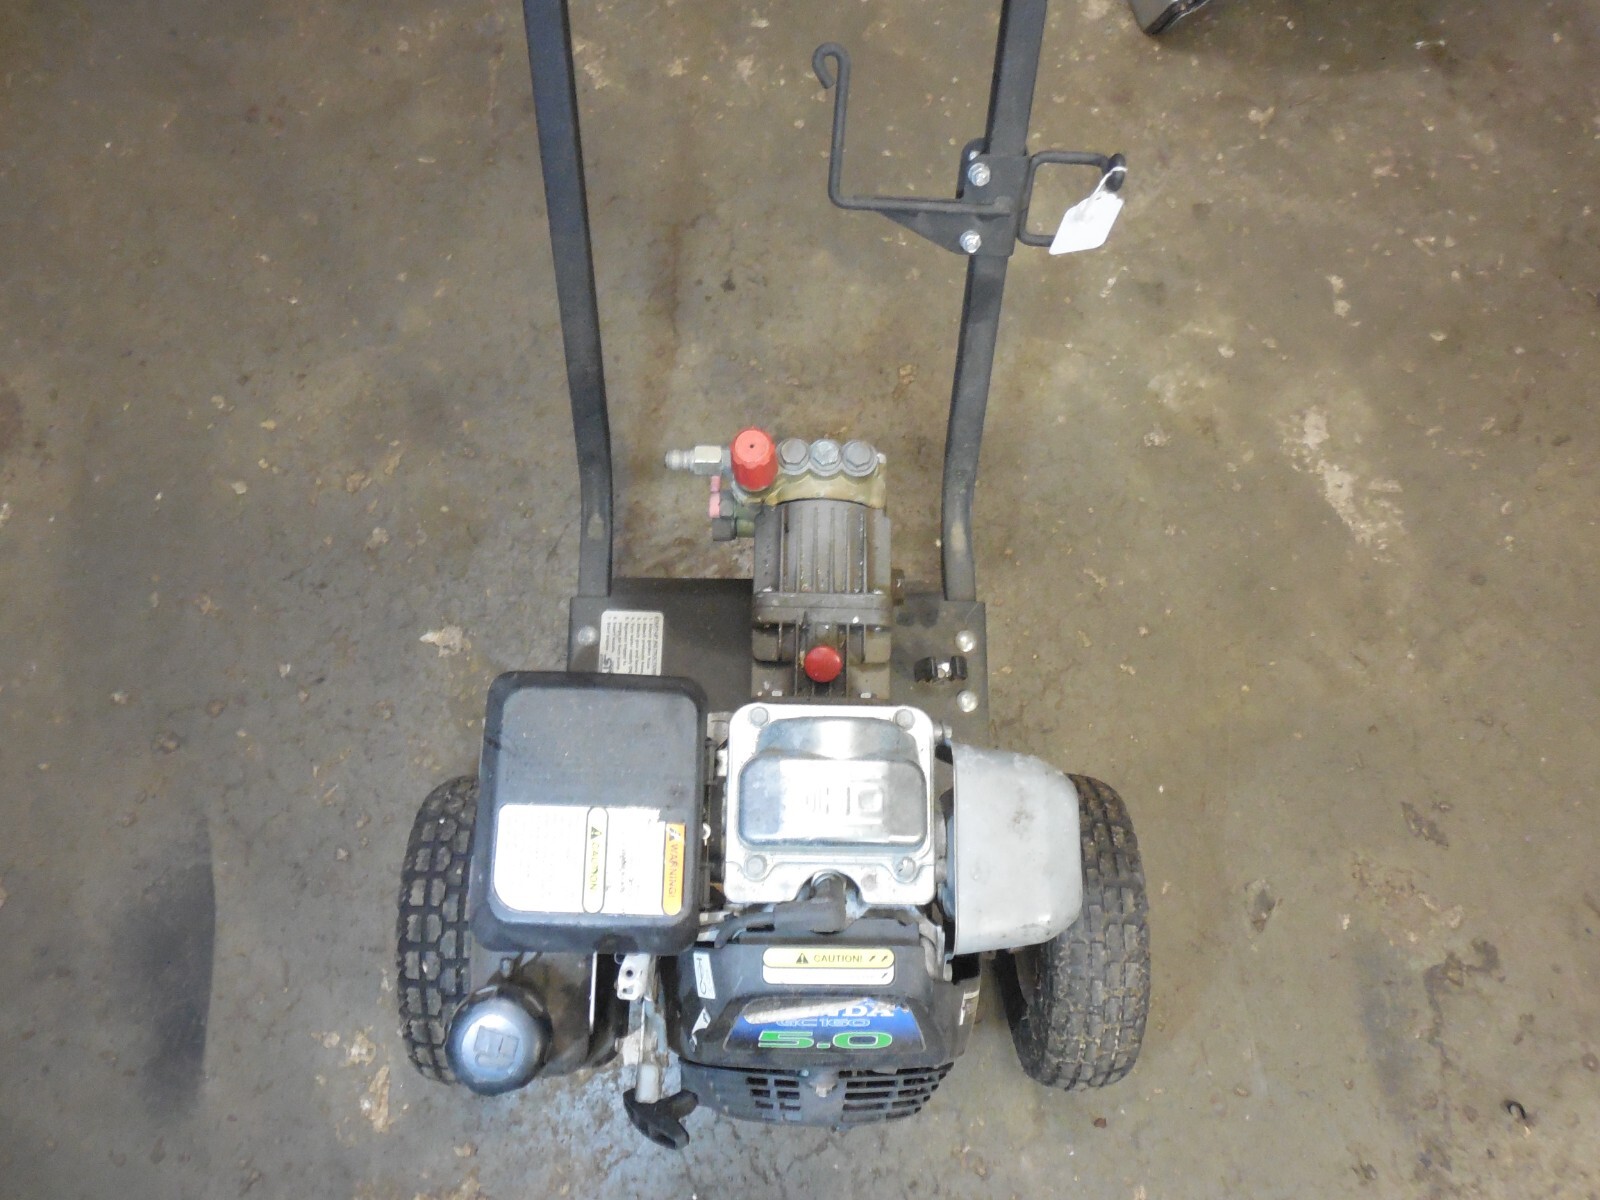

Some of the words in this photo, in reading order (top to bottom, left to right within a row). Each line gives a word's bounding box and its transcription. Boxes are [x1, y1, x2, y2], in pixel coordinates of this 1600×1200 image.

[668, 842, 679, 898] WARNING!
[813, 954, 863, 963] CAUTION!
[758, 1030, 893, 1049] 5.0
